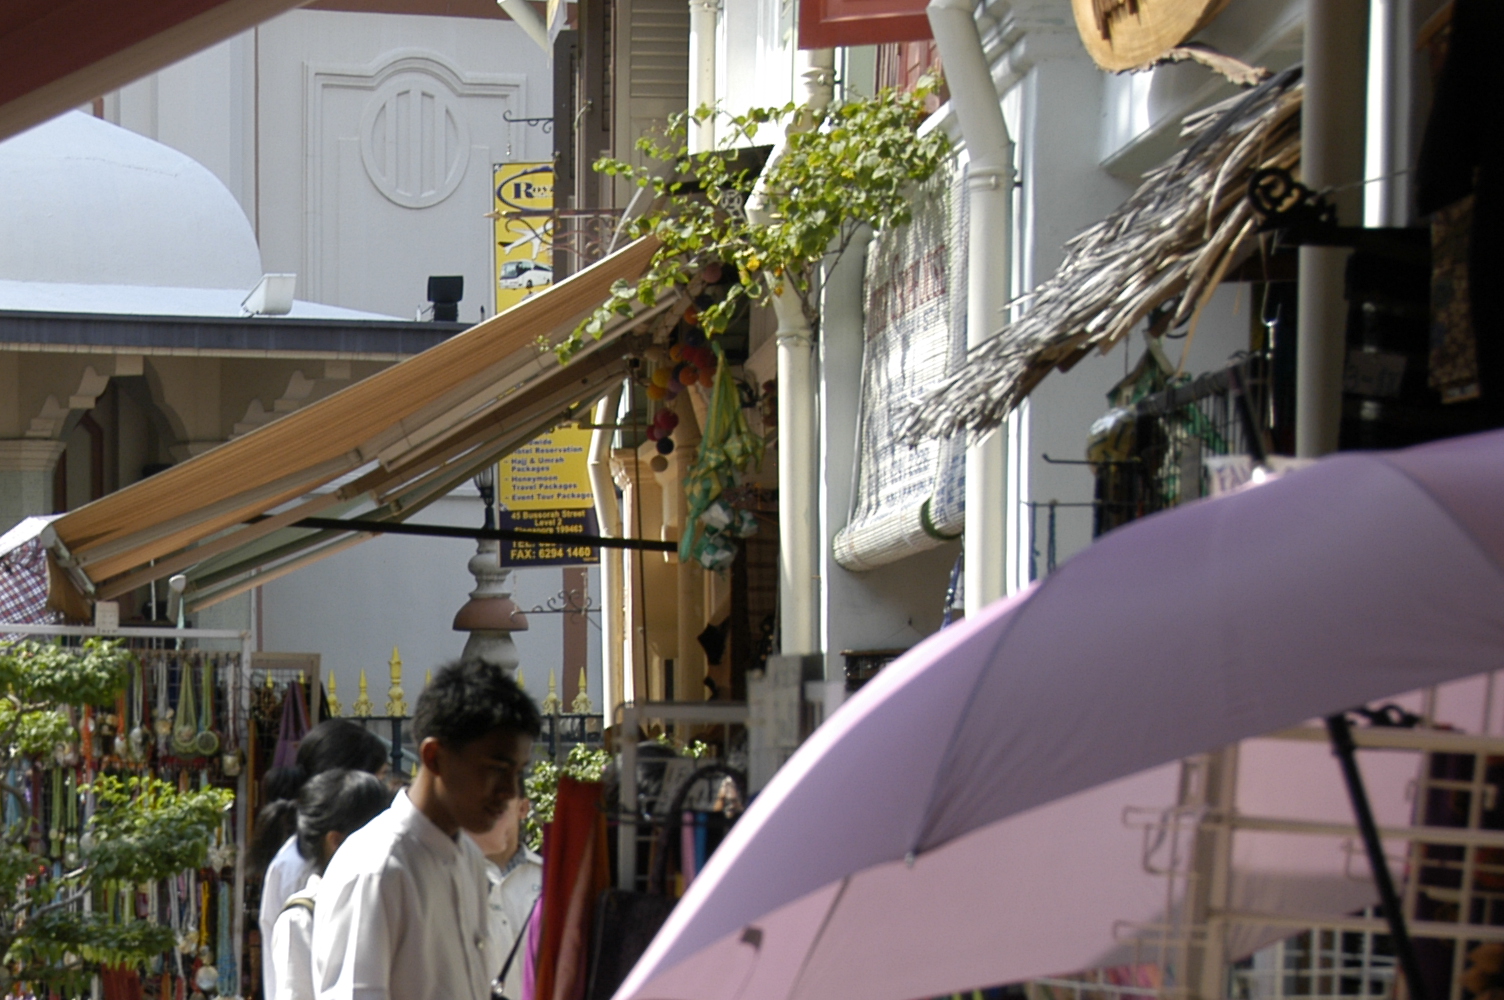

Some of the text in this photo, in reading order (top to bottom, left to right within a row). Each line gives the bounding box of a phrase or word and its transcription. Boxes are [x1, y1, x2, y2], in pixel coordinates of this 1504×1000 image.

[535, 446, 583, 454] Reservation
[511, 475, 558, 483] Honeymoon
[511, 510, 585, 520] 45 Bussorah Street
[510, 546, 591, 559] FAX: 6294 1460
